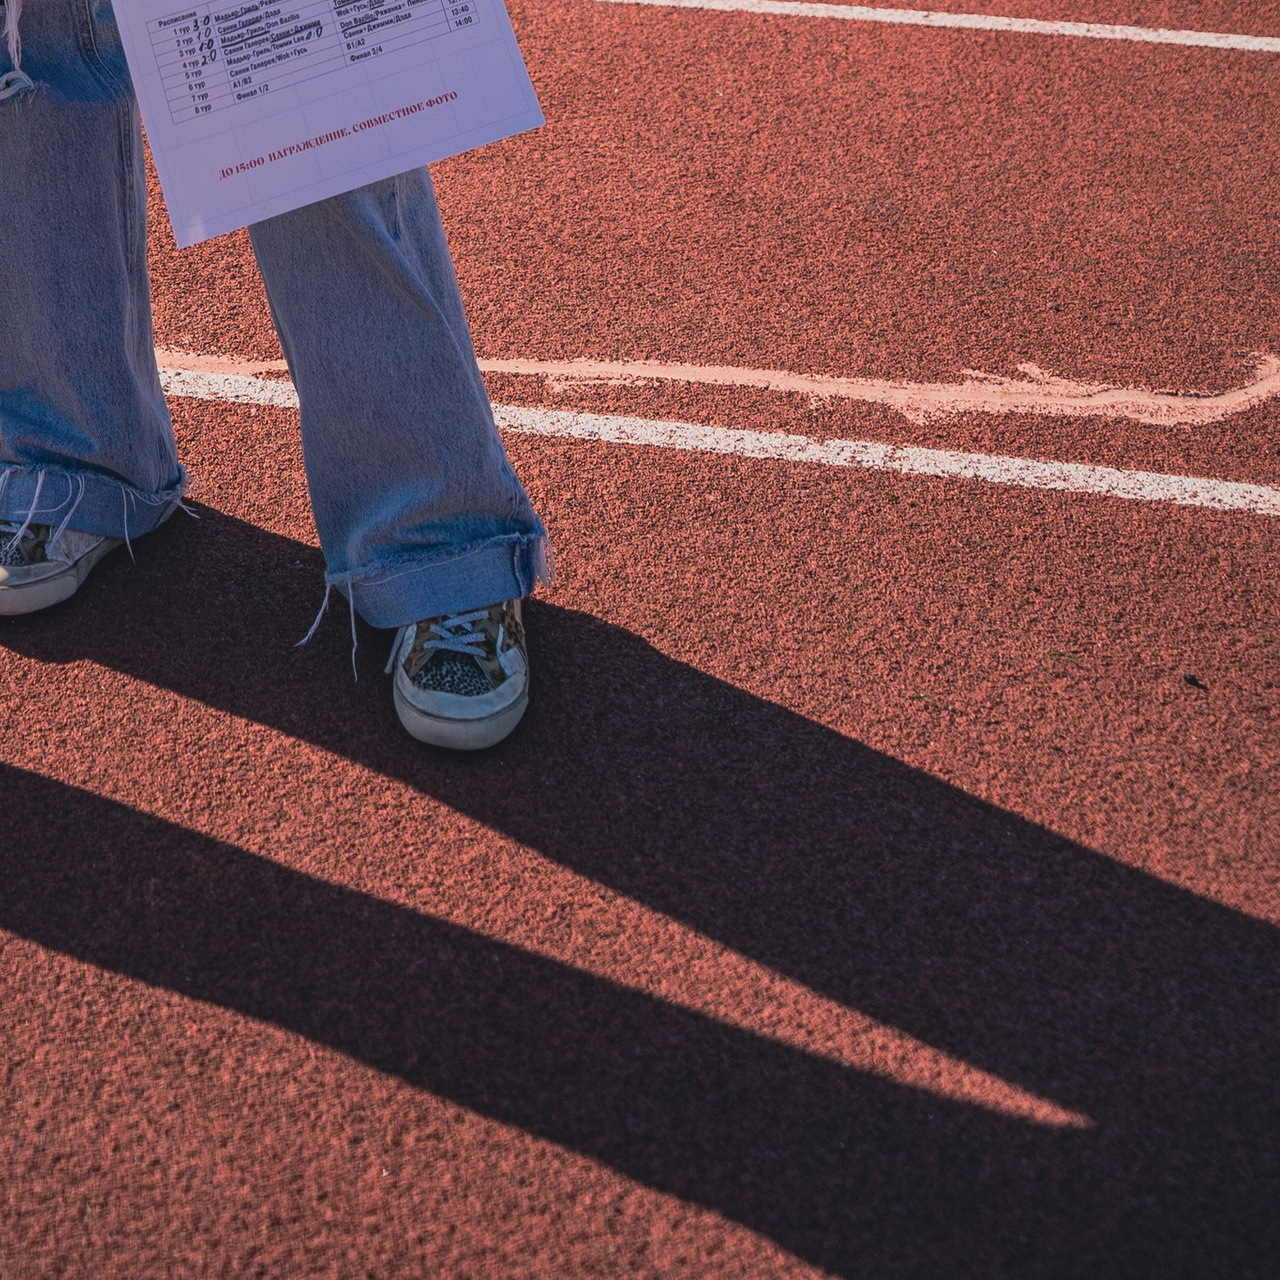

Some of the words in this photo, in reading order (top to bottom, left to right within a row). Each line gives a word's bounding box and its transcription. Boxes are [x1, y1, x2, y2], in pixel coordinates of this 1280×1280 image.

[451, 4, 469, 16] 13:40
[158, 11, 197, 28] Расписание
[455, 16, 473, 28] 14:00
[218, 23, 238, 35] Санни
[340, 21, 352, 29] Don
[179, 26, 190, 34] тур
[182, 37, 193, 46] тур
[293, 35, 305, 43] Lee
[185, 47, 196, 56] тур
[224, 46, 244, 56] Санни
[350, 52, 371, 62] Финал
[372, 45, 383, 55] 3/4
[188, 59, 200, 68] тур
[190, 69, 202, 78] тур
[229, 66, 250, 77] Санни
[194, 81, 205, 90] тур
[197, 92, 209, 101] тур
[236, 88, 258, 100] Финал
[259, 84, 269, 94] 1/2
[200, 104, 212, 113] тур
[219, 167, 233, 181] ДО
[235, 157, 265, 174] 15:00
[269, 127, 351, 163] НАГРАЖДЕНИЕ.
[352, 101, 425, 133] СОВМЕСТНОЕ
[426, 90, 458, 109] ФОТО
